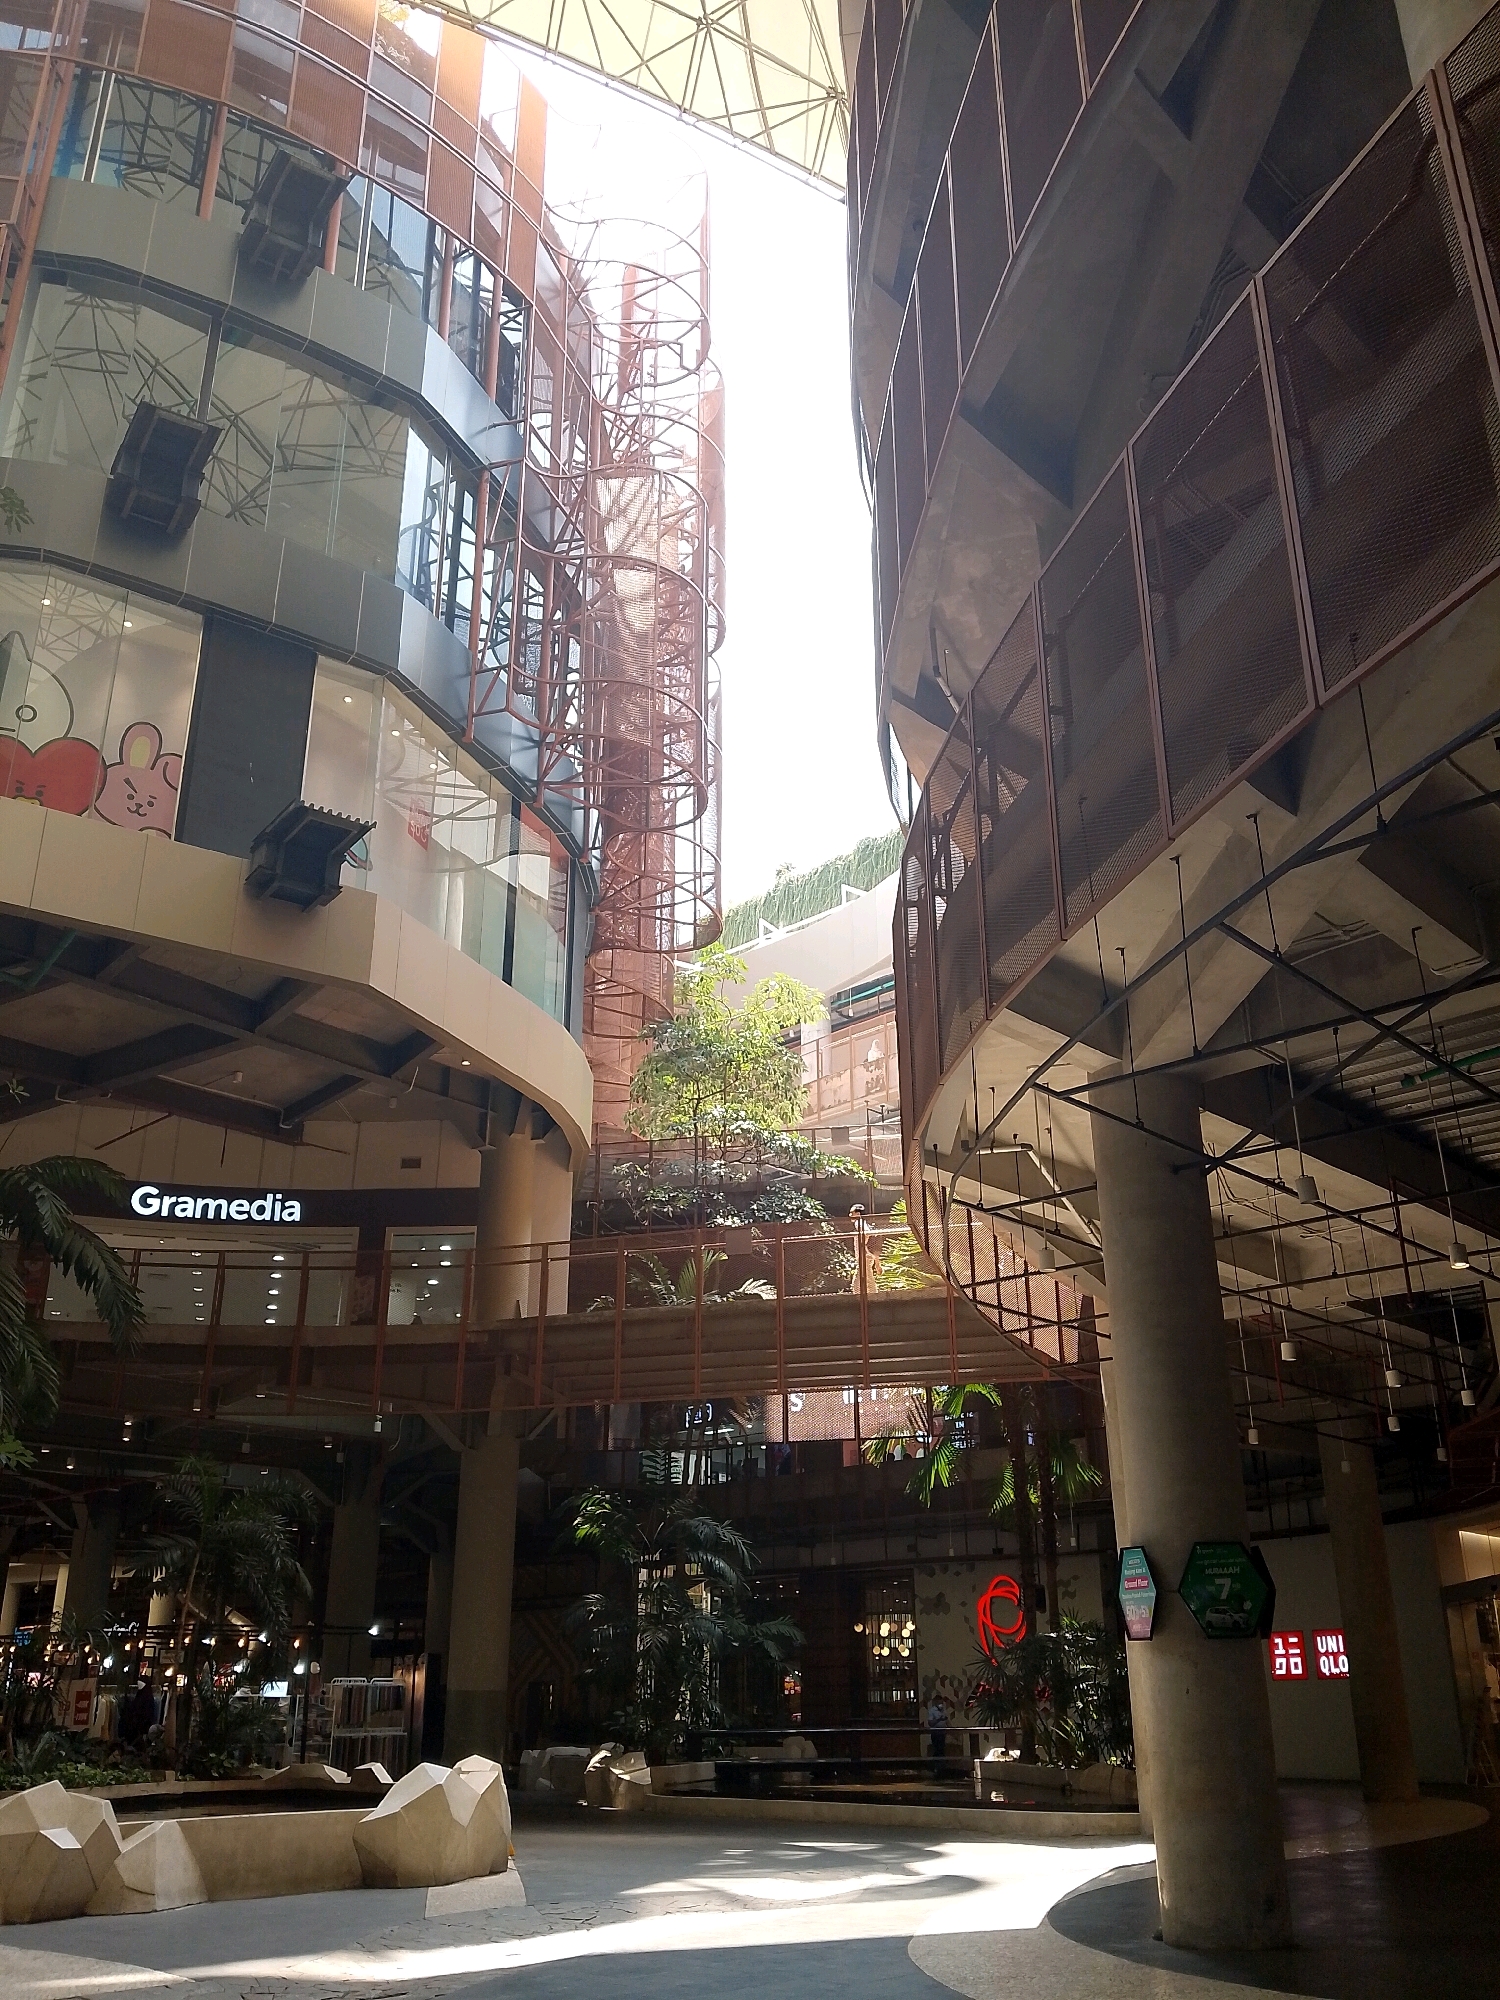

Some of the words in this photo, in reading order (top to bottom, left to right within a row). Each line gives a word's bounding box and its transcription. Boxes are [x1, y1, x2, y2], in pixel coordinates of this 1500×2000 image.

[130, 1186, 301, 1222] Gramedia
[1214, 1578, 1232, 1600] 7
[1316, 1634, 1345, 1653] UNI
[1319, 1654, 1350, 1676] QLO
